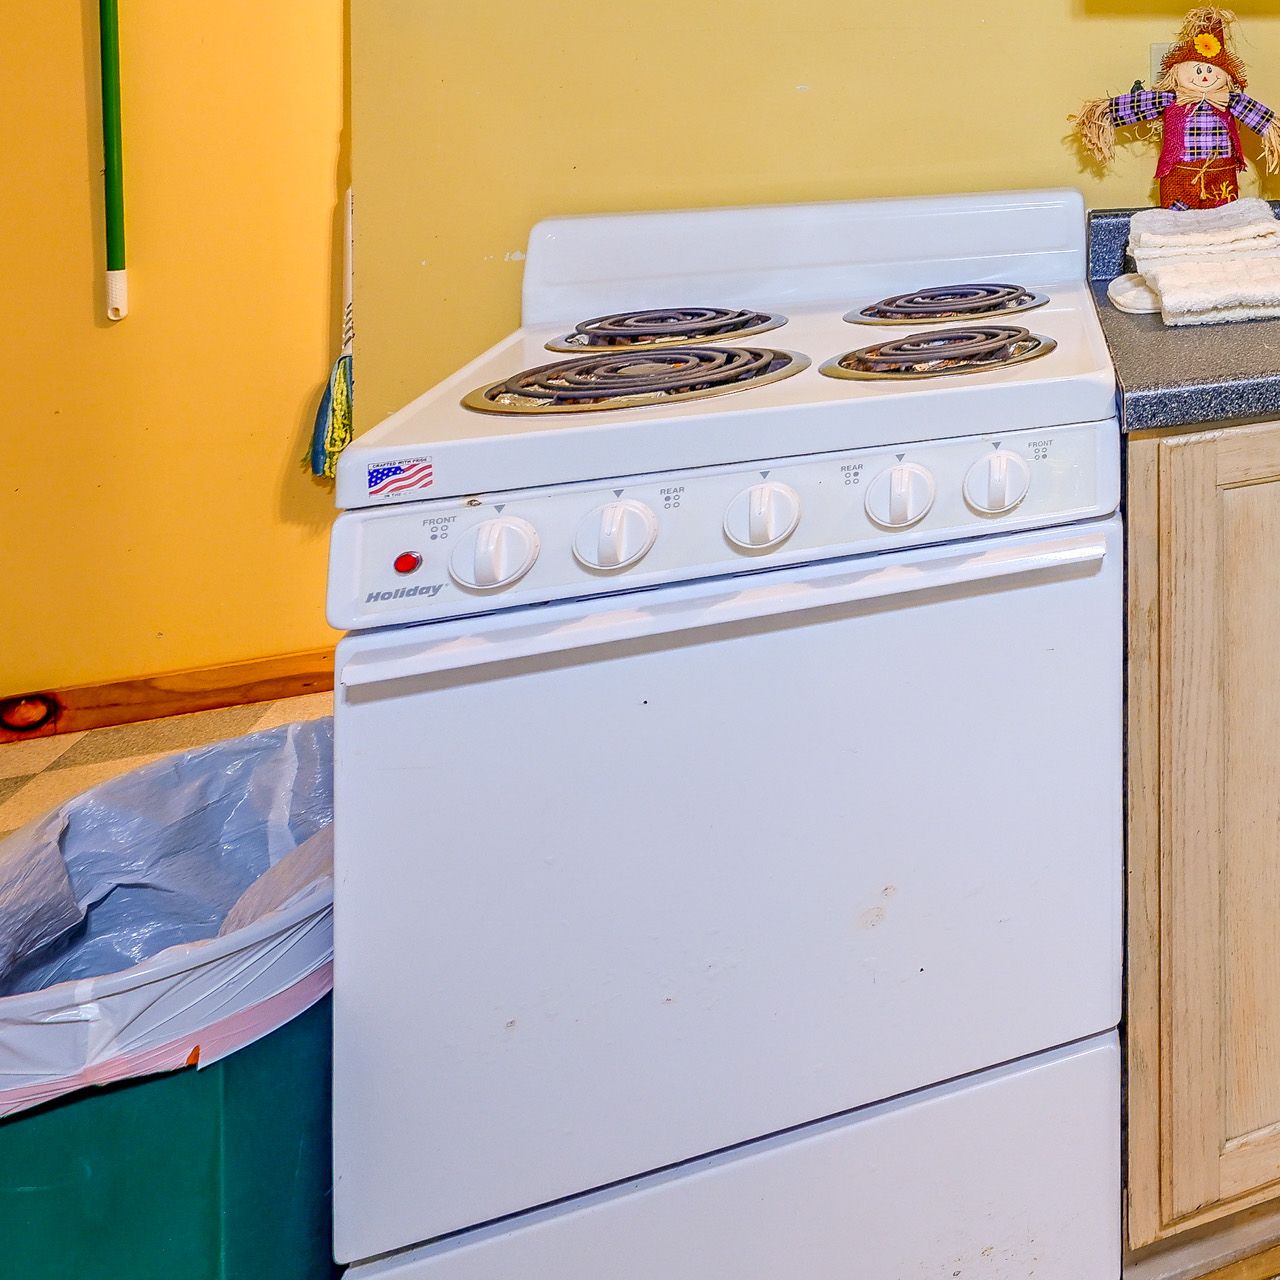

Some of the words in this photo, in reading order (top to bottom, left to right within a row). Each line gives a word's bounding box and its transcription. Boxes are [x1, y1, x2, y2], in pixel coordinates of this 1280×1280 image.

[1028, 439, 1053, 449] FRONT
[840, 463, 864, 472] REAR
[660, 486, 685, 495] REAR
[422, 516, 457, 526] FRONT
[365, 583, 444, 604] Holiday
